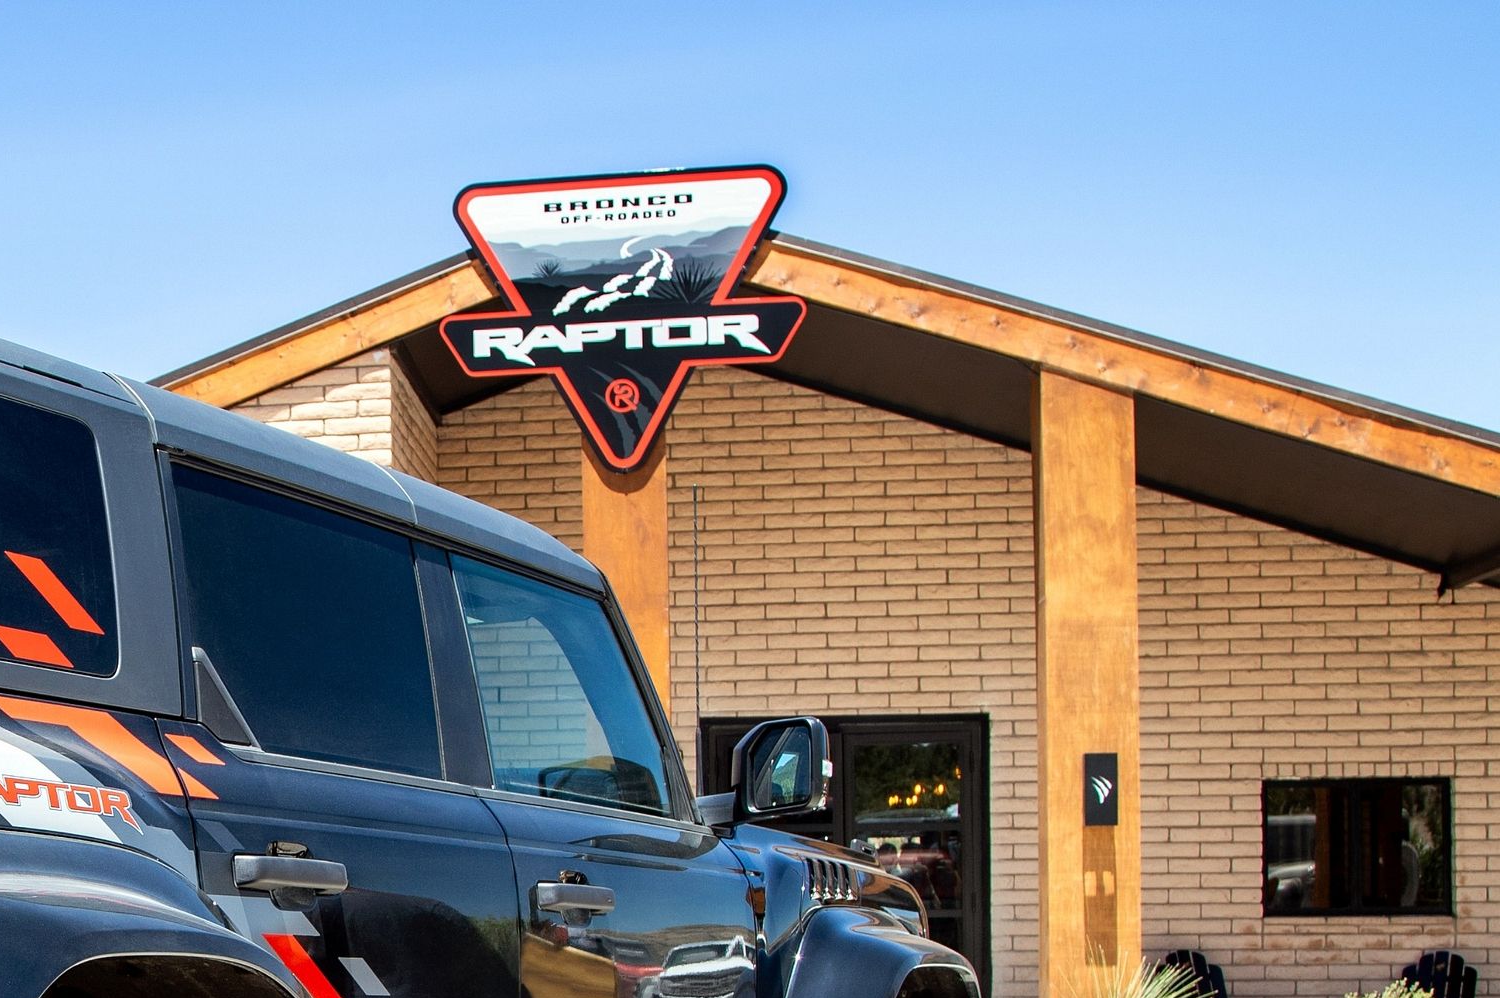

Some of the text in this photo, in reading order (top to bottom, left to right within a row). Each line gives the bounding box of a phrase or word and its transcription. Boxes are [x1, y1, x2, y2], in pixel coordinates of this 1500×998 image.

[543, 194, 693, 212] BRONCO
[560, 209, 677, 224] OFF-ROADEO
[473, 313, 772, 366] RAPTOR
